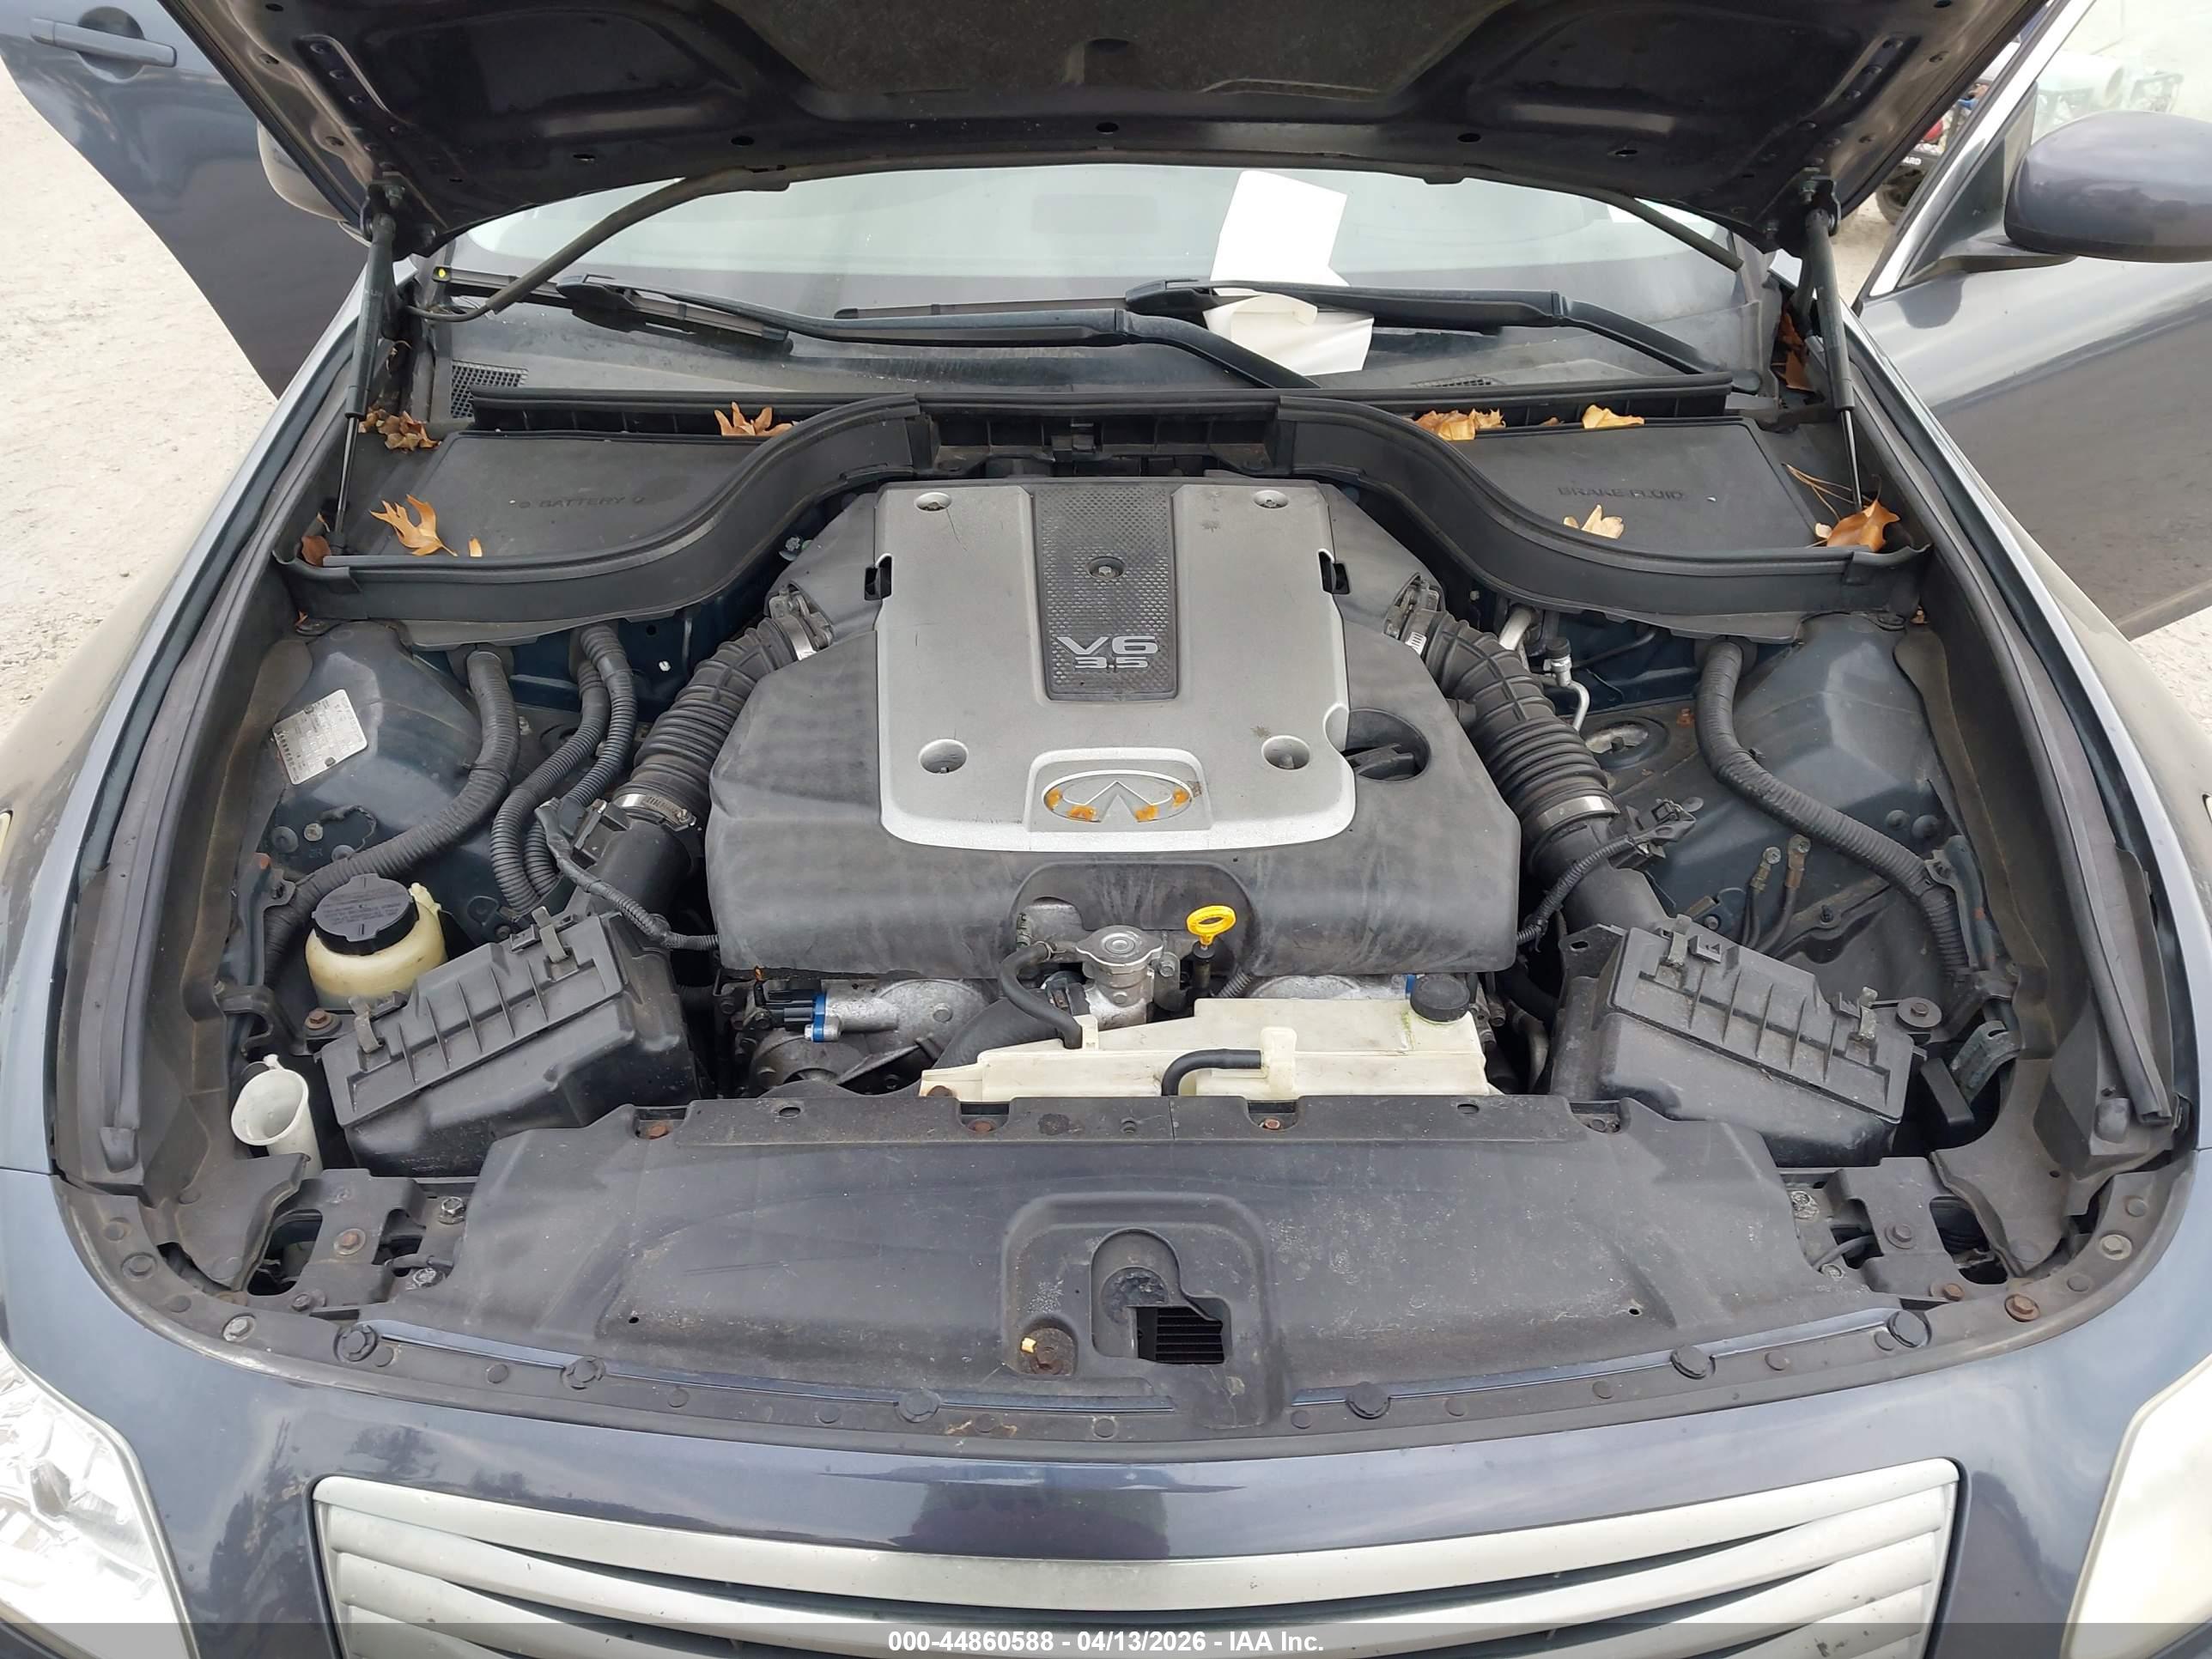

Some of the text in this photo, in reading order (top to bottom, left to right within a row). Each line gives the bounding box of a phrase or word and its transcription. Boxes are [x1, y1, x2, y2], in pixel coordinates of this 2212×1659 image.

[538, 495, 626, 508] BATTERY
[1056, 635, 1158, 655] V6
[1074, 656, 1149, 668] 3.5
